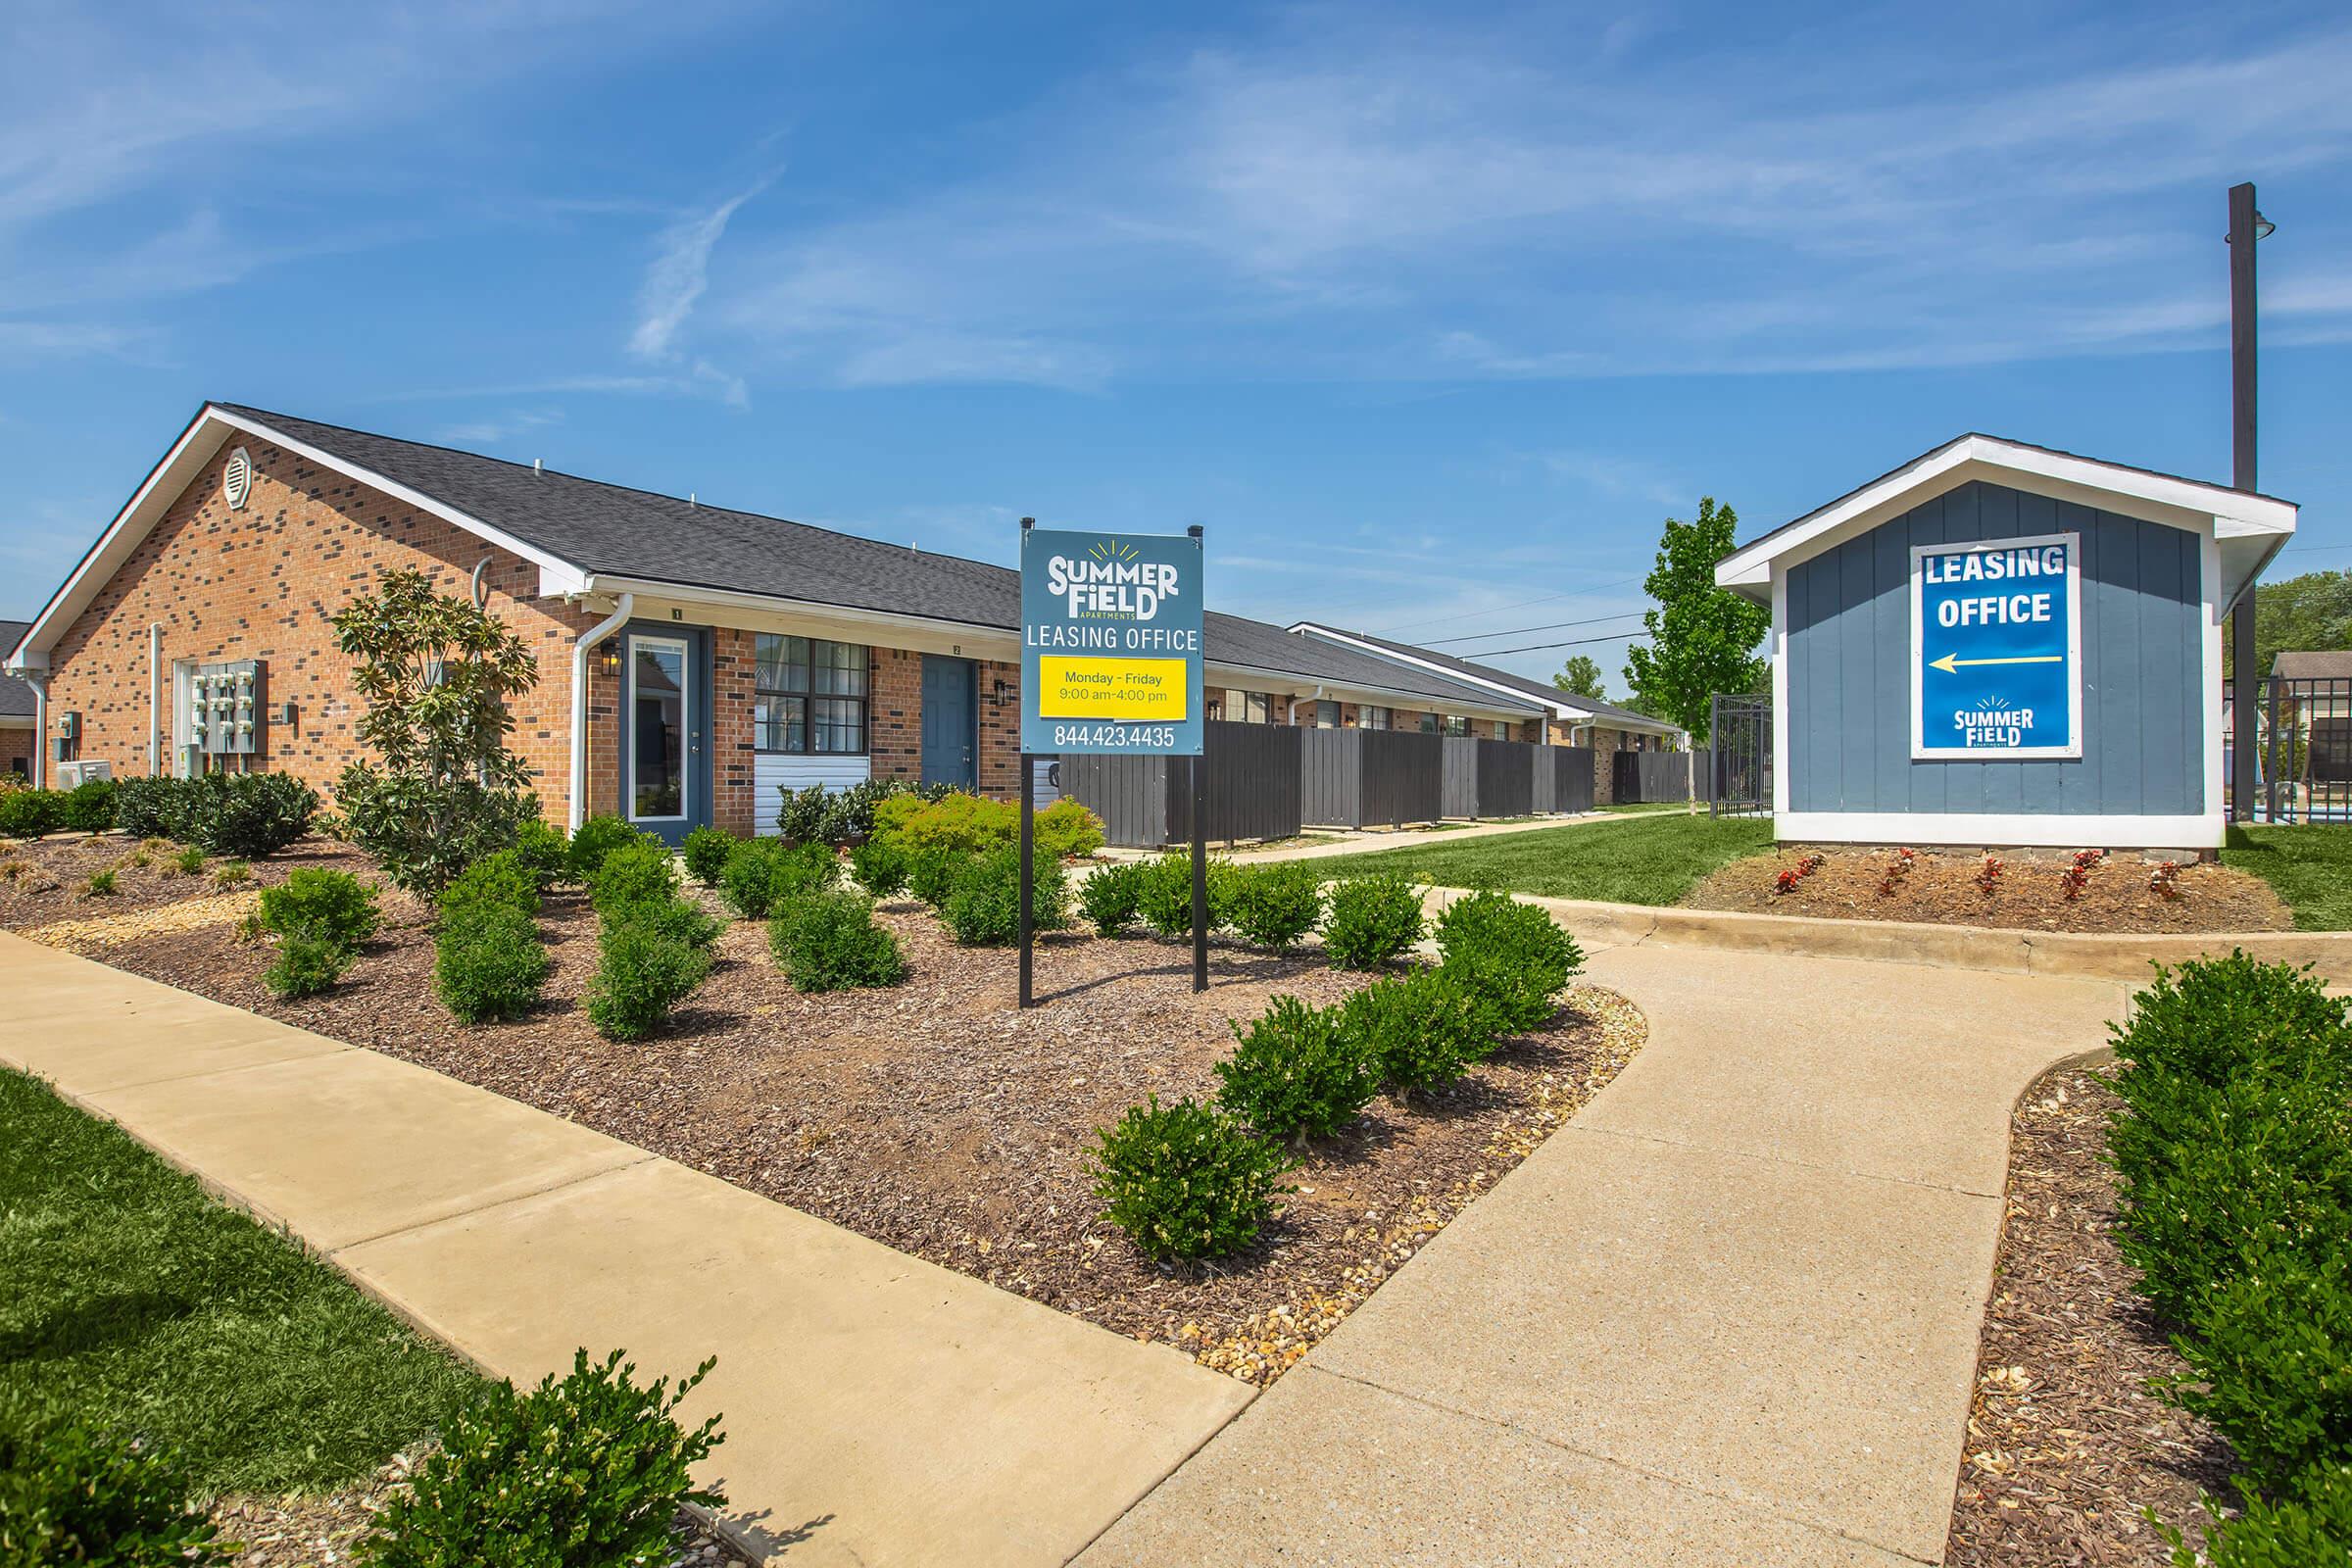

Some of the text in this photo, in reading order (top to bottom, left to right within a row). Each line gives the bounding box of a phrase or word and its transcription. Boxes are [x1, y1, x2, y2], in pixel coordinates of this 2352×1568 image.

[1926, 546, 2064, 584] LEASING
[1048, 555, 1179, 600] SUMMER
[1080, 612, 1136, 621] APARTMENTS
[1937, 593, 2051, 627] OFFICE
[1027, 624, 1198, 651] LEASING OFFICE
[1065, 671, 1113, 686] Monday
[1125, 672, 1162, 687] Friday
[1059, 688, 1089, 700] 9:00
[1148, 691, 1167, 704] pm
[1953, 708, 2034, 730] SUMMER
[1054, 725, 1174, 748] 844.423.4435
